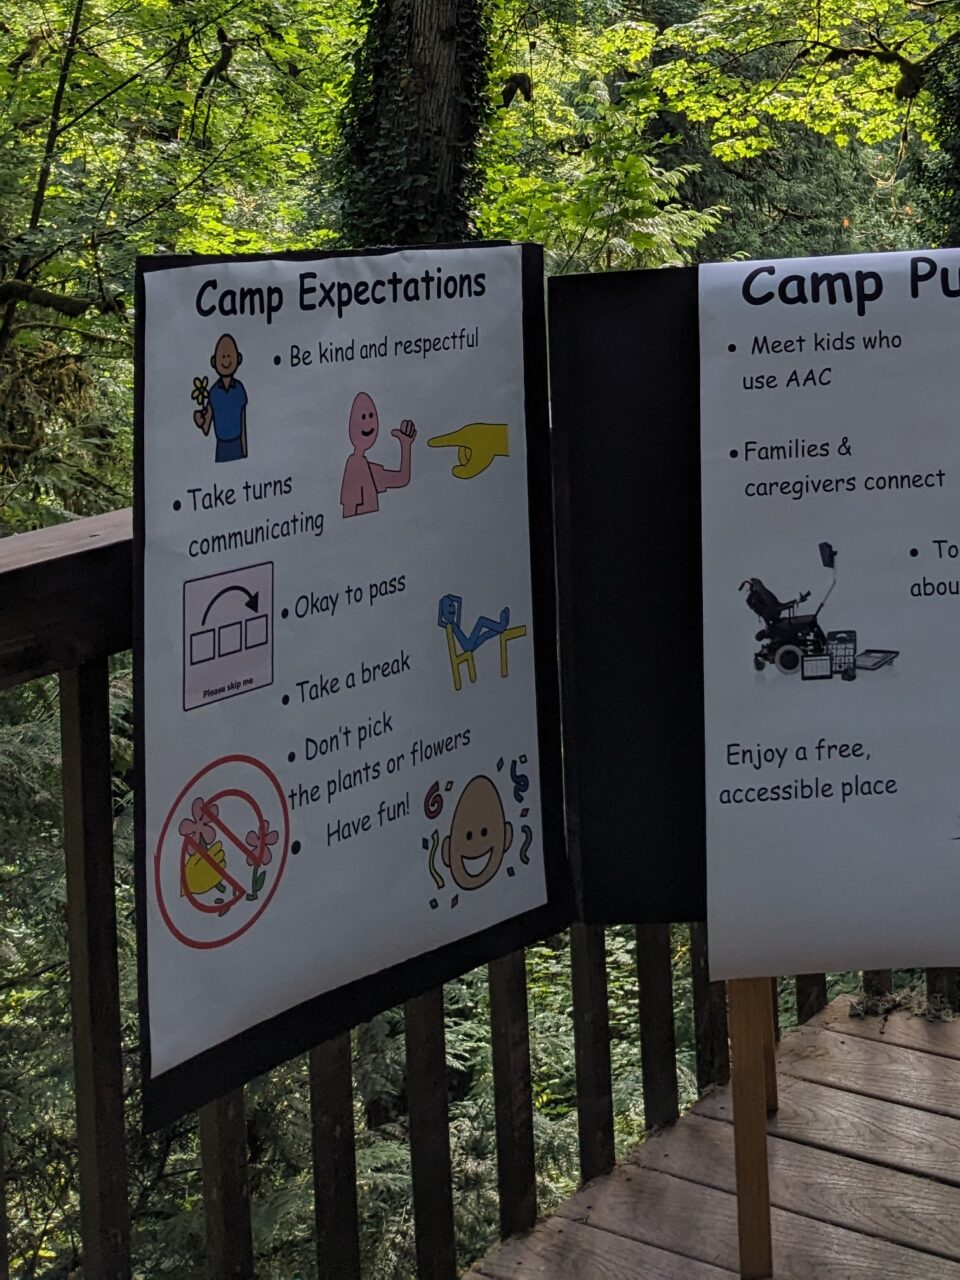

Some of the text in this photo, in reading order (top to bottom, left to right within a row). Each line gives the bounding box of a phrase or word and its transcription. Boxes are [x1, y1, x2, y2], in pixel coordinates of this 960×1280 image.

[196, 267, 487, 324] Camp Expectations
[742, 265, 883, 317] Camp
[290, 327, 479, 368] Be kind and respectful
[751, 331, 902, 355] Meet kids who
[743, 368, 832, 391] use AAC
[744, 437, 852, 461] Families &
[188, 476, 292, 512] Take turns
[745, 469, 946, 500] caregivers connect
[189, 512, 324, 558] communicating
[933, 539, 959, 559] To
[295, 574, 406, 619] Okay to pass
[203, 678, 254, 698] Please skip me
[296, 651, 410, 704] Take a break
[305, 711, 393, 762] Don't pick
[727, 738, 871, 769] Enjoy a free,
[288, 729, 471, 811] the plants or flowers
[719, 777, 898, 804] accessible place
[327, 792, 410, 847] Have fun!
